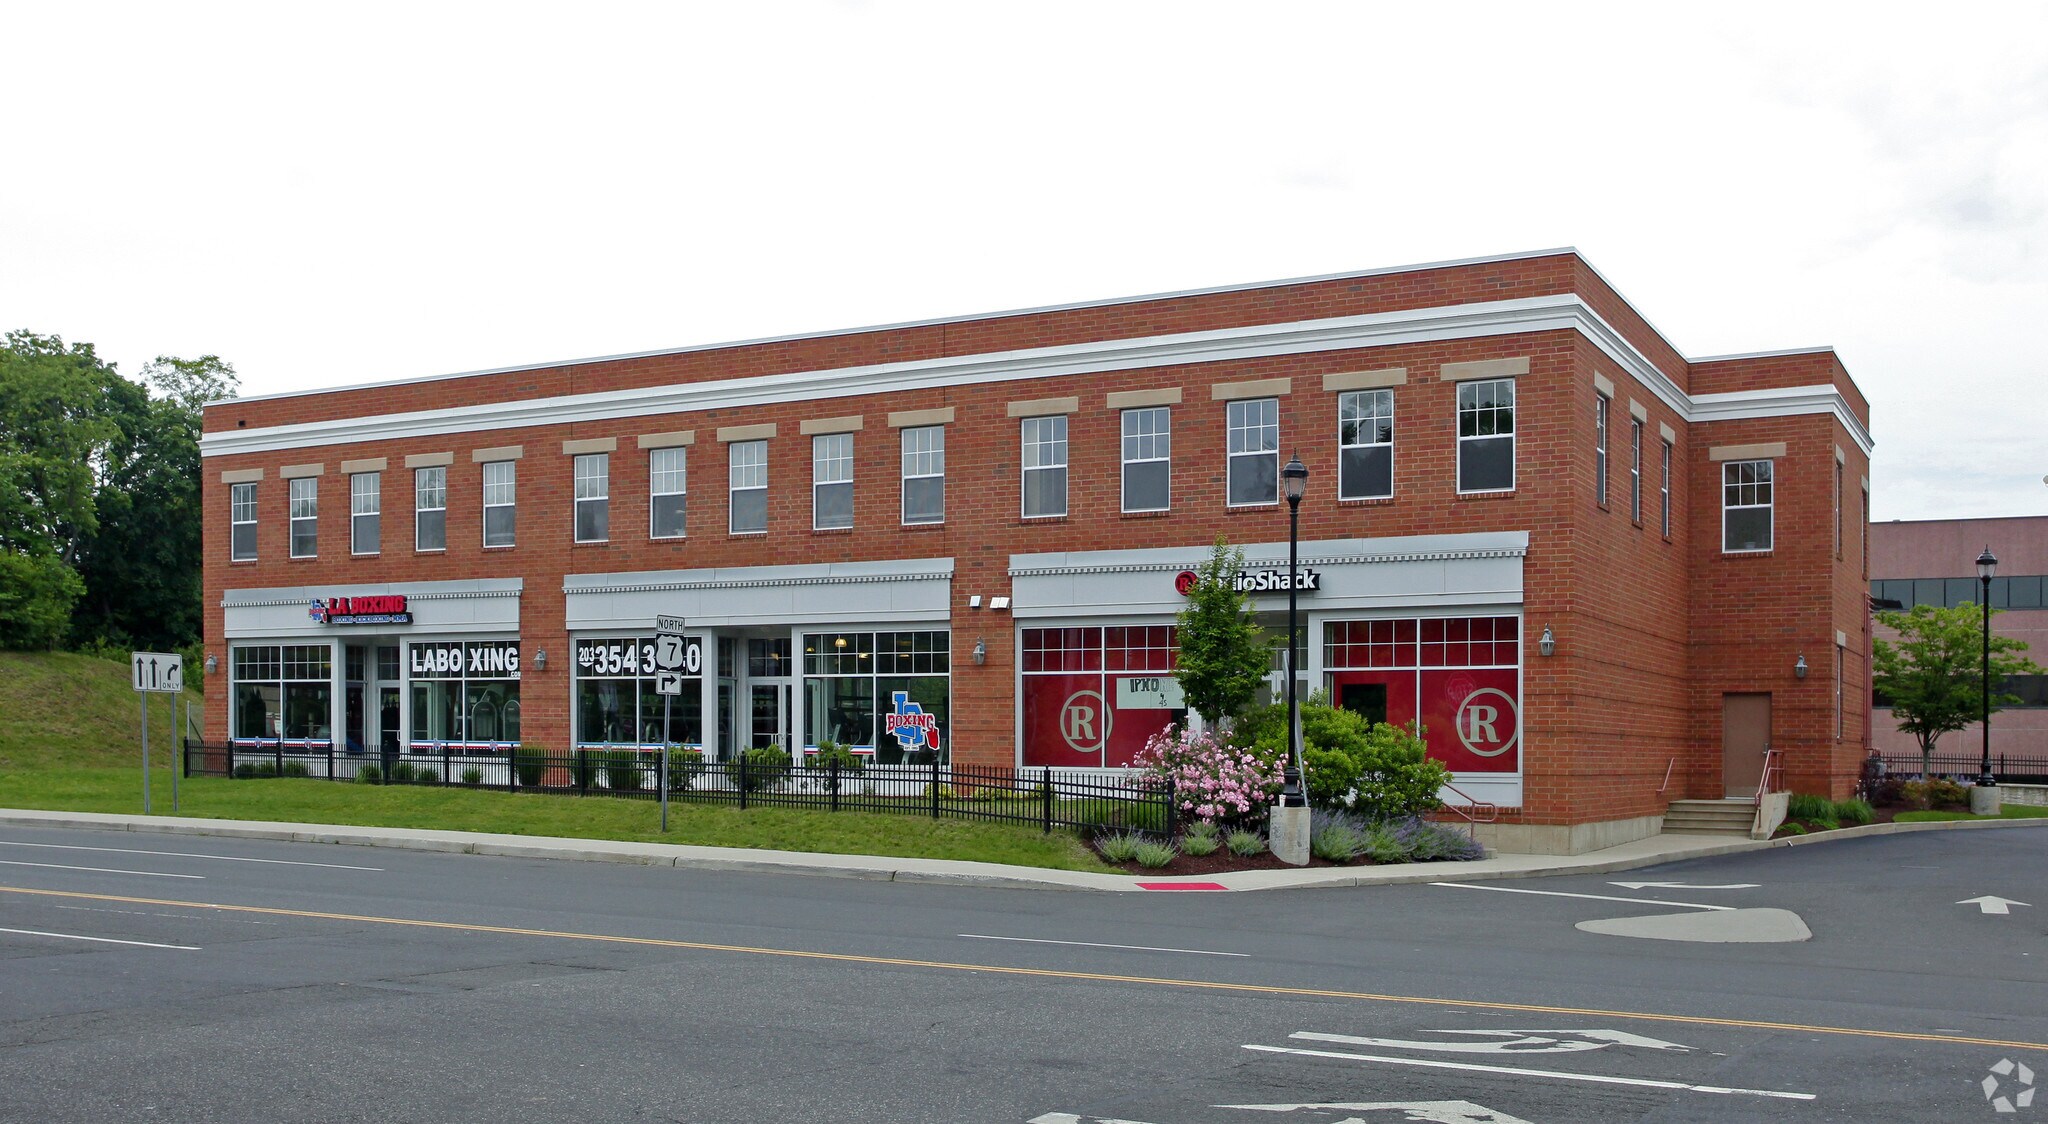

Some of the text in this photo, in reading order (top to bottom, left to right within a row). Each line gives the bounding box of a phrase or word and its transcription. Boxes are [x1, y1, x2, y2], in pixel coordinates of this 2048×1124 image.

[1199, 569, 1315, 592] ioShack
[328, 597, 350, 615] LA
[350, 595, 407, 615] BOXING
[658, 619, 683, 631] NORTH
[579, 643, 701, 673] 203 354 30
[667, 642, 677, 661] 7
[886, 714, 935, 733] BOXING
